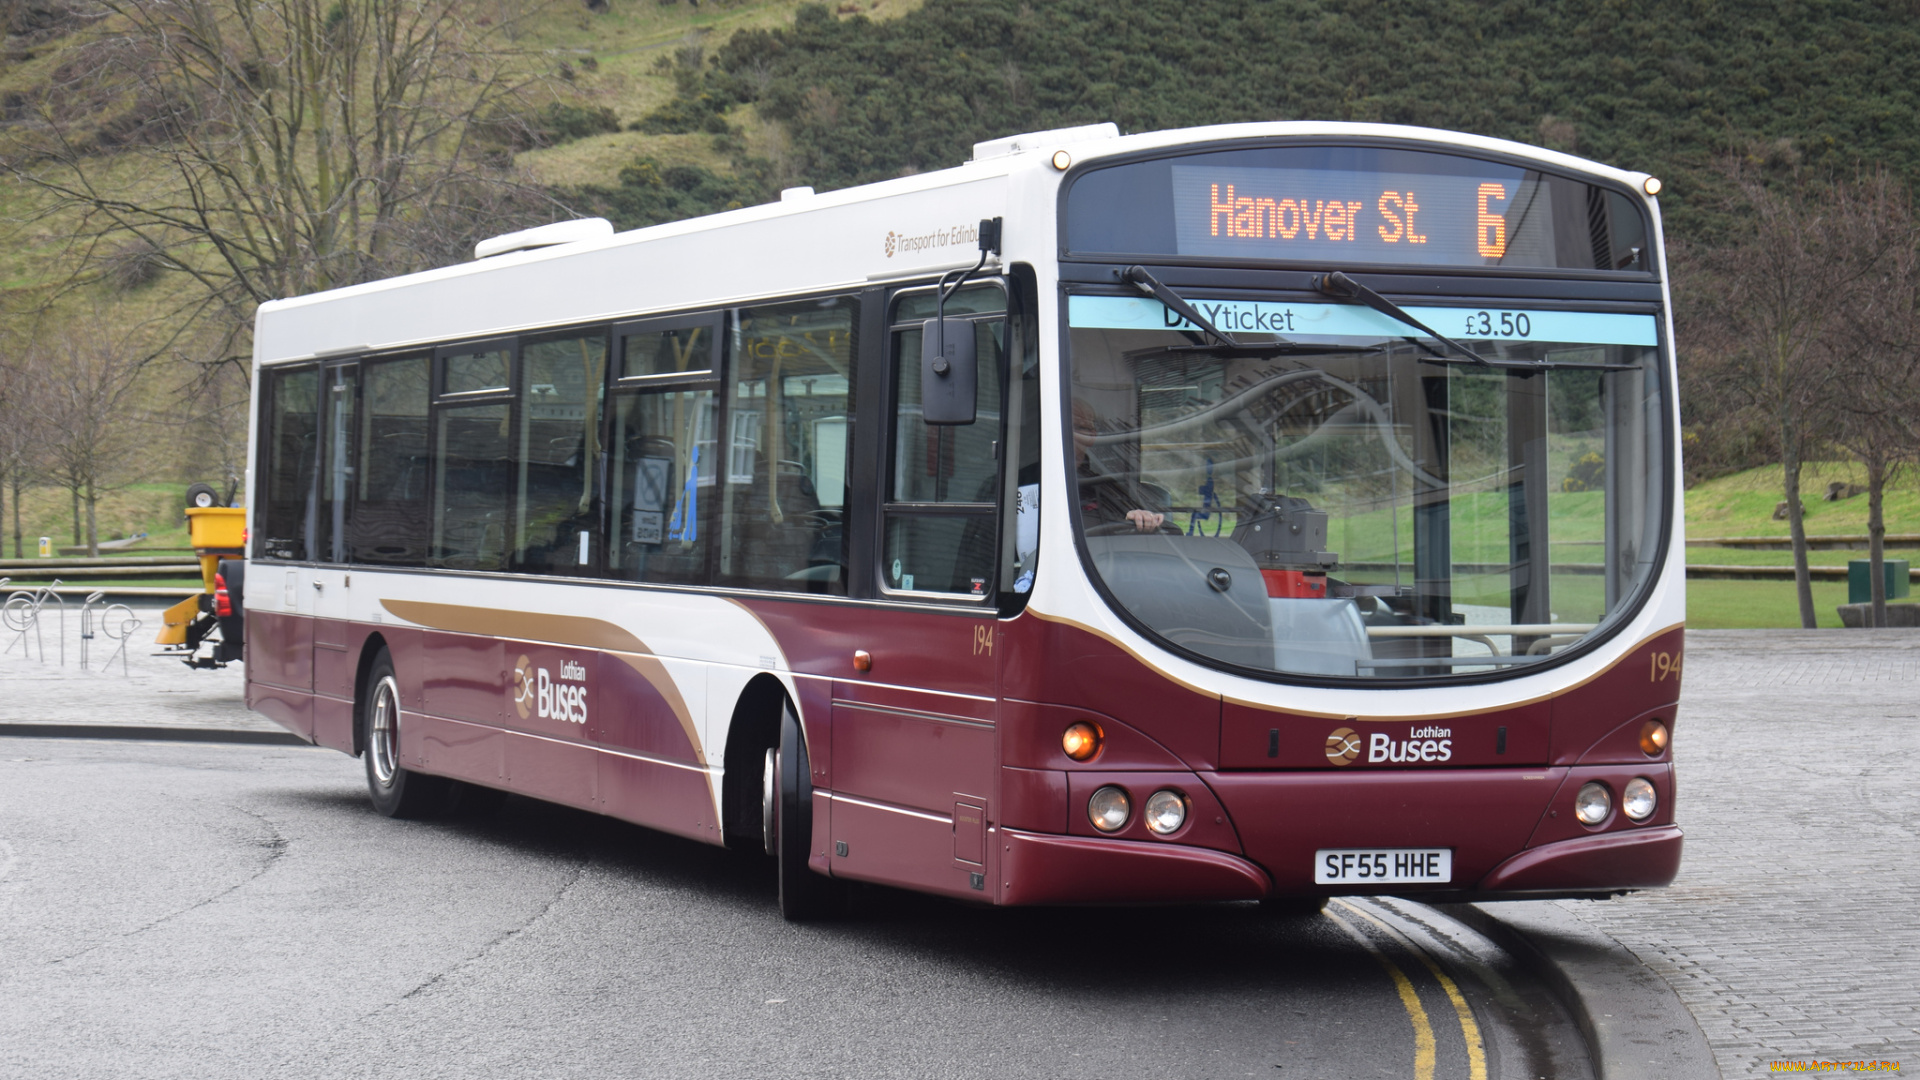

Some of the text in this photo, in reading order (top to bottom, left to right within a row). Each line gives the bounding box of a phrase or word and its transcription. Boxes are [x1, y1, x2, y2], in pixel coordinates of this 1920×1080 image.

[1211, 183, 1427, 243] Hanover St.
[1477, 183, 1506, 258] 6
[897, 223, 980, 254] Transport for Edinbu
[1465, 310, 1531, 338] £3.50
[973, 624, 994, 657] 194
[560, 659, 586, 682] Lothian
[1650, 650, 1682, 683] 194
[537, 667, 588, 725] Buses
[1368, 732, 1453, 763] Buses
[1410, 726, 1451, 739] Lothian
[1325, 853, 1441, 879] SF55 HHE
